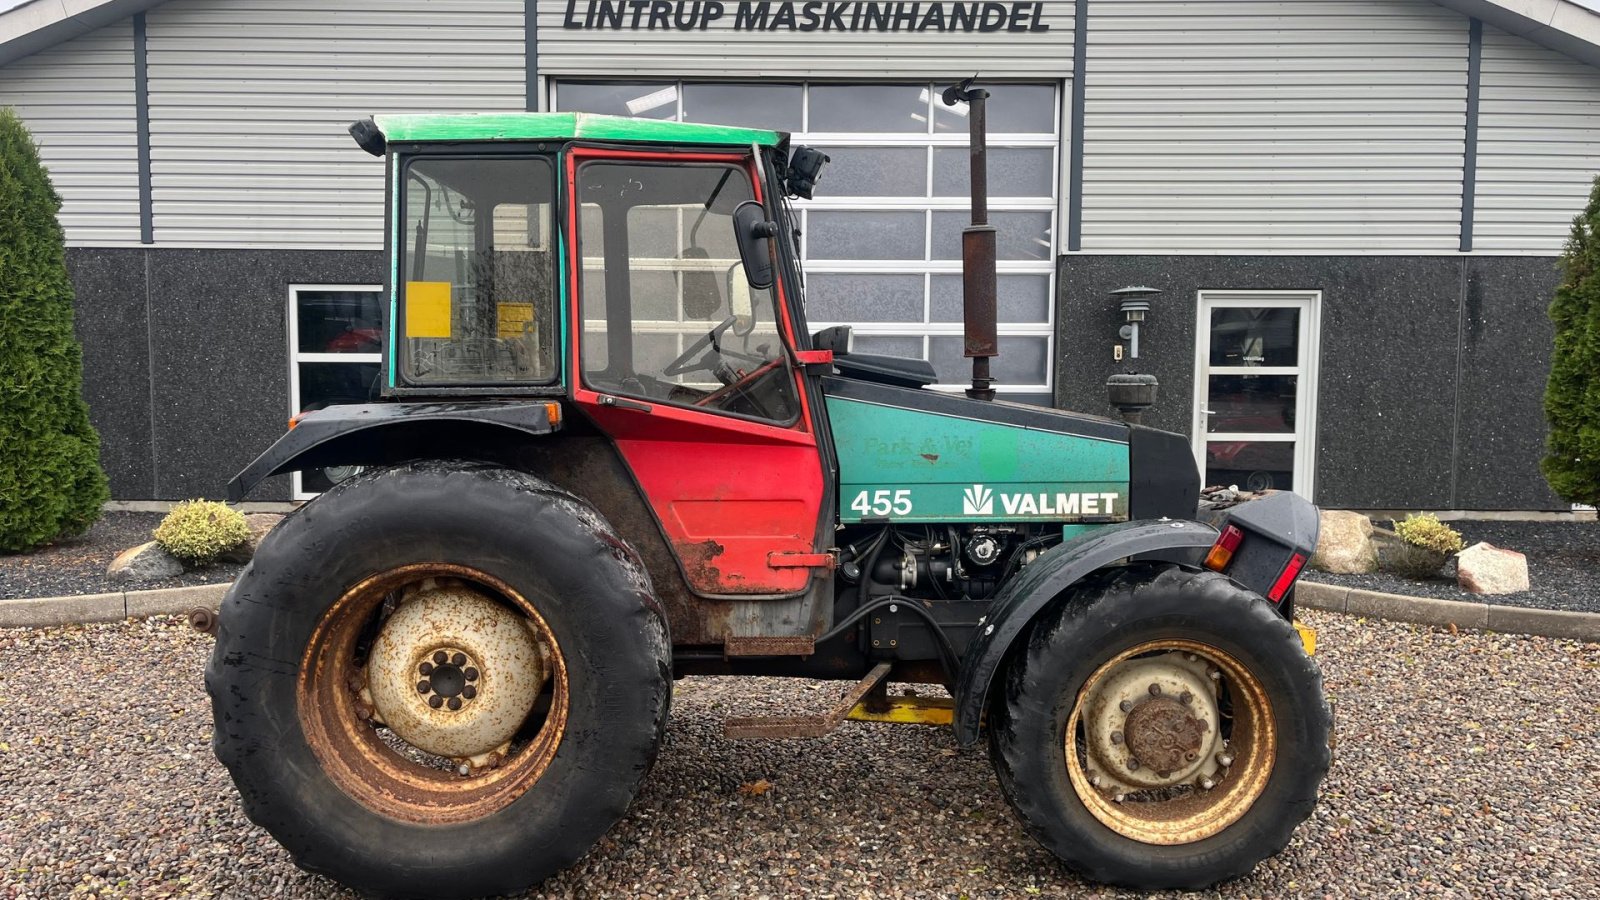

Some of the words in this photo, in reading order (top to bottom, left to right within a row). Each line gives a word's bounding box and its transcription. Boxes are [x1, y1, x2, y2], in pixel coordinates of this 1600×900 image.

[563, 1, 724, 30] LINTRUP
[734, 1, 1049, 32] MASKINHANDEL
[851, 489, 912, 515] 455
[1000, 493, 1118, 514] VALMET
